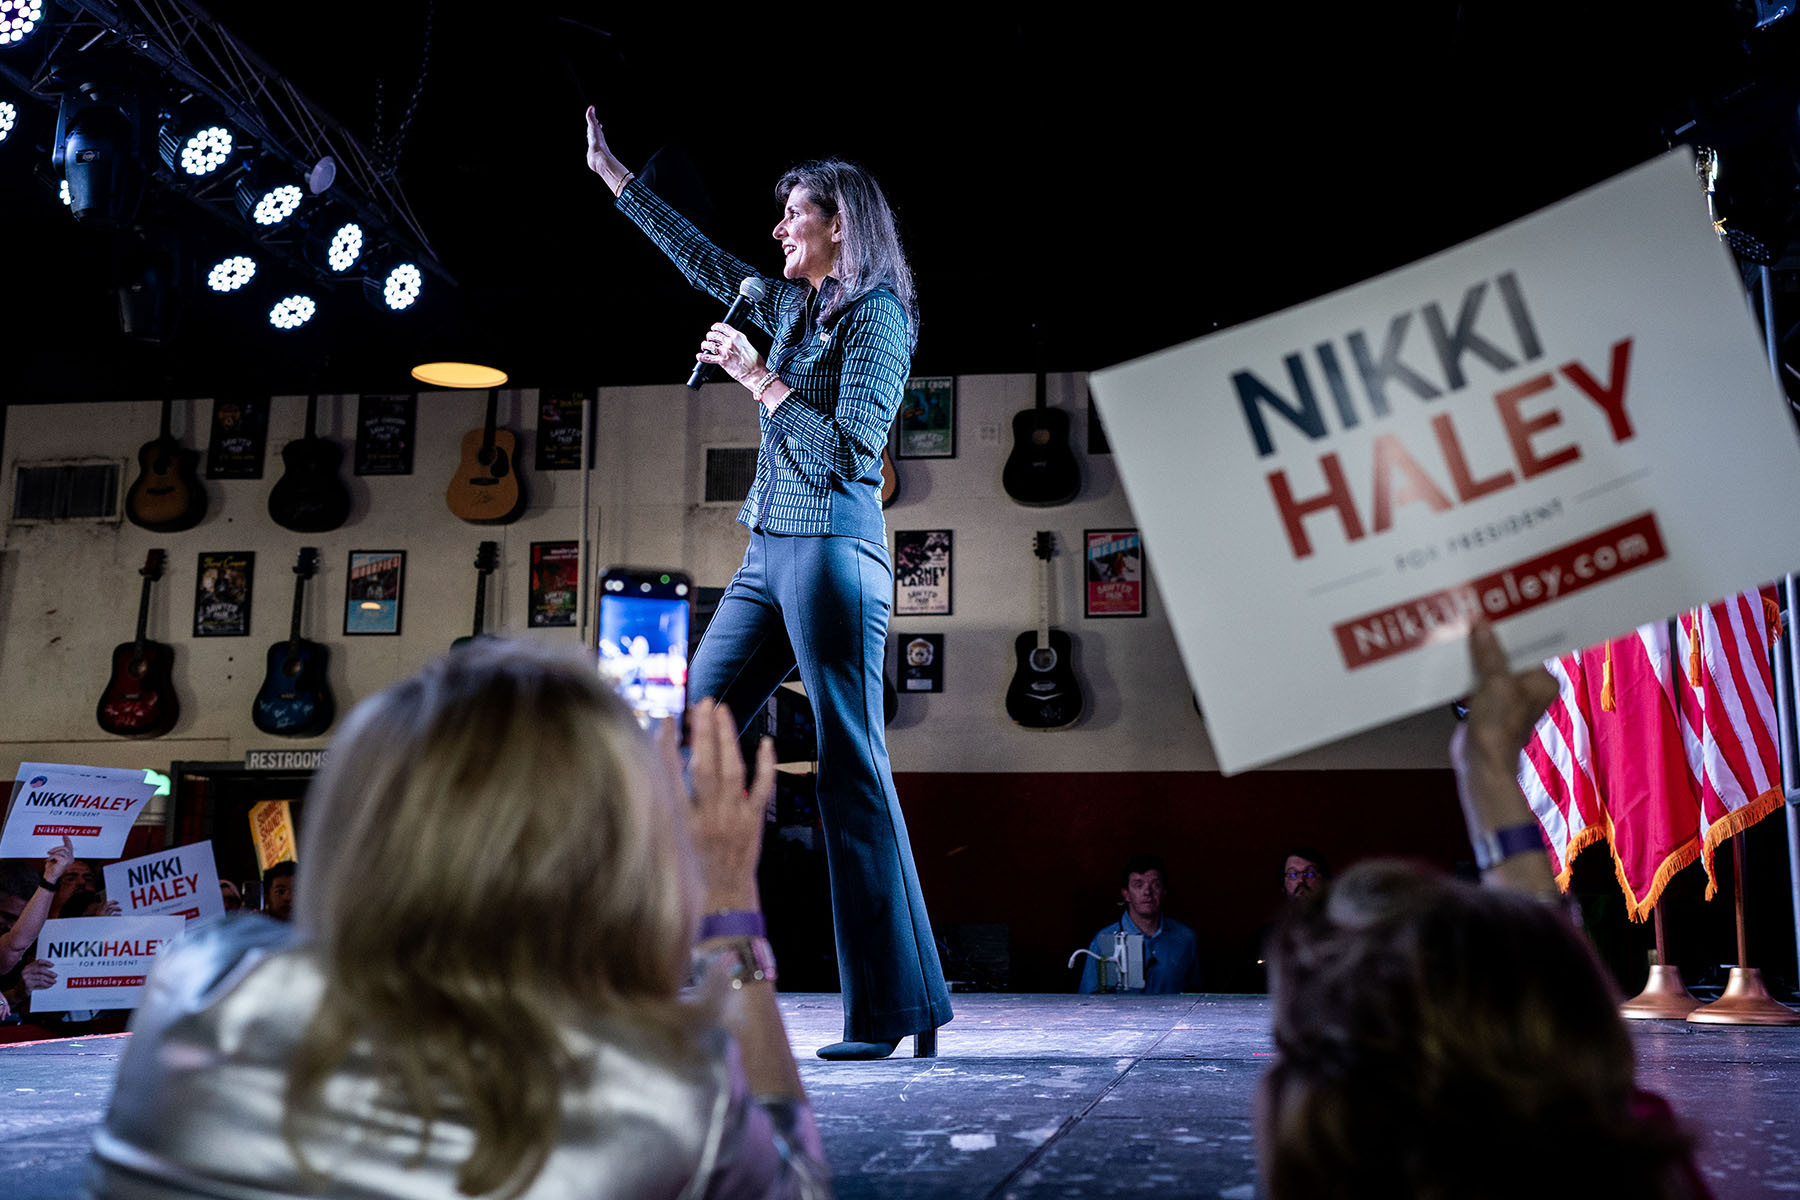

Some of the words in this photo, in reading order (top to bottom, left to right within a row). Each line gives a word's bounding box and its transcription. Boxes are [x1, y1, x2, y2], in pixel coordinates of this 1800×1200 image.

[1231, 269, 1544, 460] NIKKI
[1265, 335, 1636, 561] HALEY
[1447, 496, 1564, 553] PRESIDENT
[1351, 532, 1650, 657] NikkiHaley.com
[250, 752, 329, 769] RESTROOMS
[26, 791, 138, 811] NIKKIHALEY
[37, 826, 99, 836] NikkiHaley.com
[128, 856, 183, 888] NIKKI
[131, 873, 199, 910] HALEY
[71, 978, 144, 987] NikkiHaley.com
